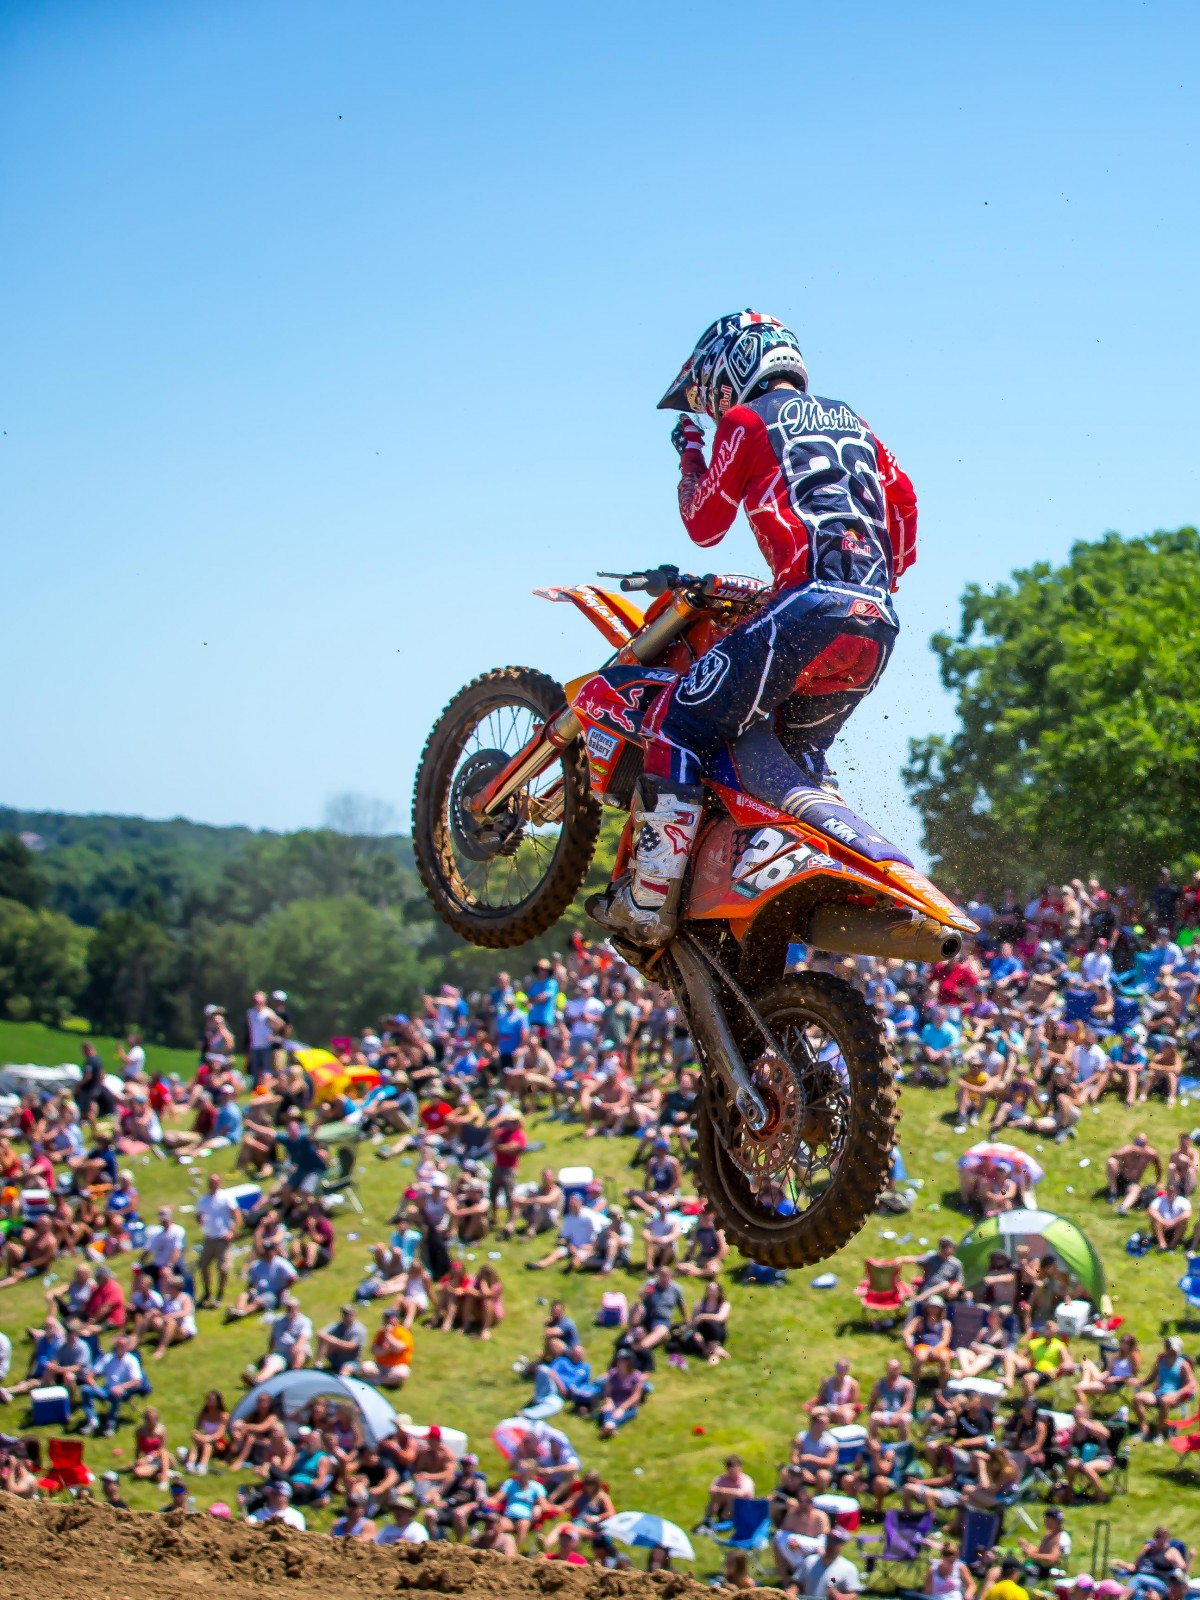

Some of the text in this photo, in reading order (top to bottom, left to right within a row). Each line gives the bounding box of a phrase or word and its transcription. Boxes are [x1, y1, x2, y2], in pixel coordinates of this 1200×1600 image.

[778, 398, 862, 434] Martin
[589, 739, 611, 757] bakery
[748, 799, 780, 820] seaspan
[822, 817, 859, 842] KTM
[731, 827, 811, 891] 26
